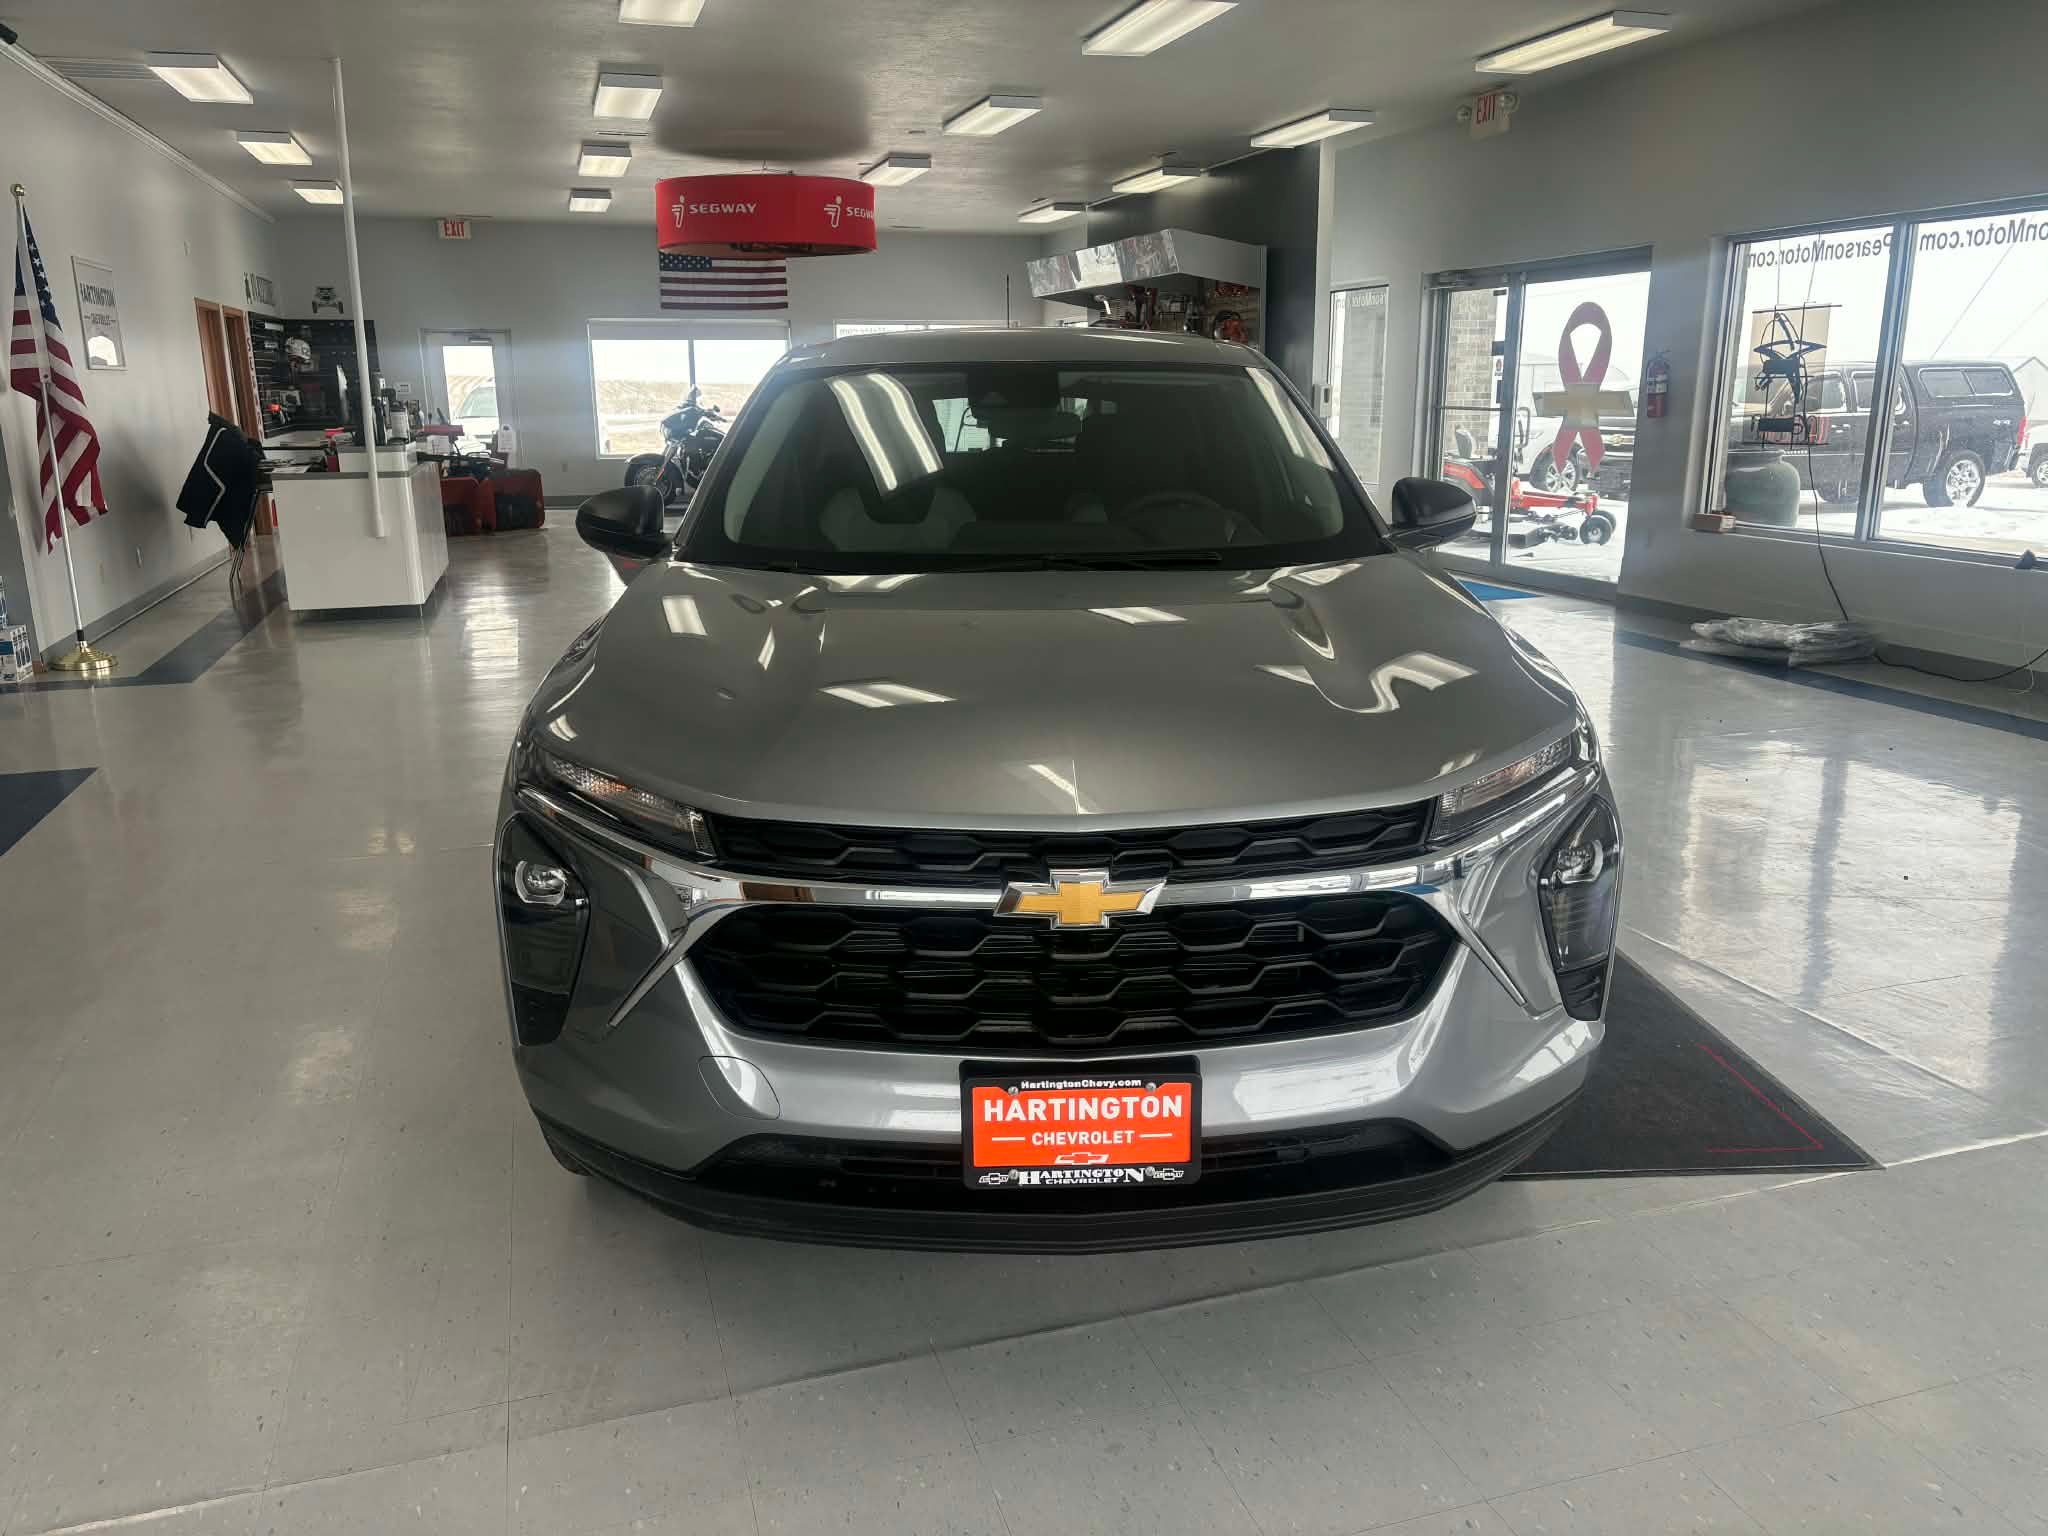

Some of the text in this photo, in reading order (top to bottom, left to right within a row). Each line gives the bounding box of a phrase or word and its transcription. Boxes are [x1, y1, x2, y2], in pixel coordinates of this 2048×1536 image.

[1475, 94, 1496, 124] EXIT
[688, 203, 757, 214] SEGWAY
[444, 220, 465, 237] EXIT
[1021, 1079, 1142, 1089] HartingtonChevy.com
[984, 1095, 1183, 1122] HARTINGTON
[1032, 1130, 1135, 1146] CHEVROLET
[1018, 1167, 1146, 1185] HARTINGTON
[1045, 1177, 1118, 1185] CHEVROLET
